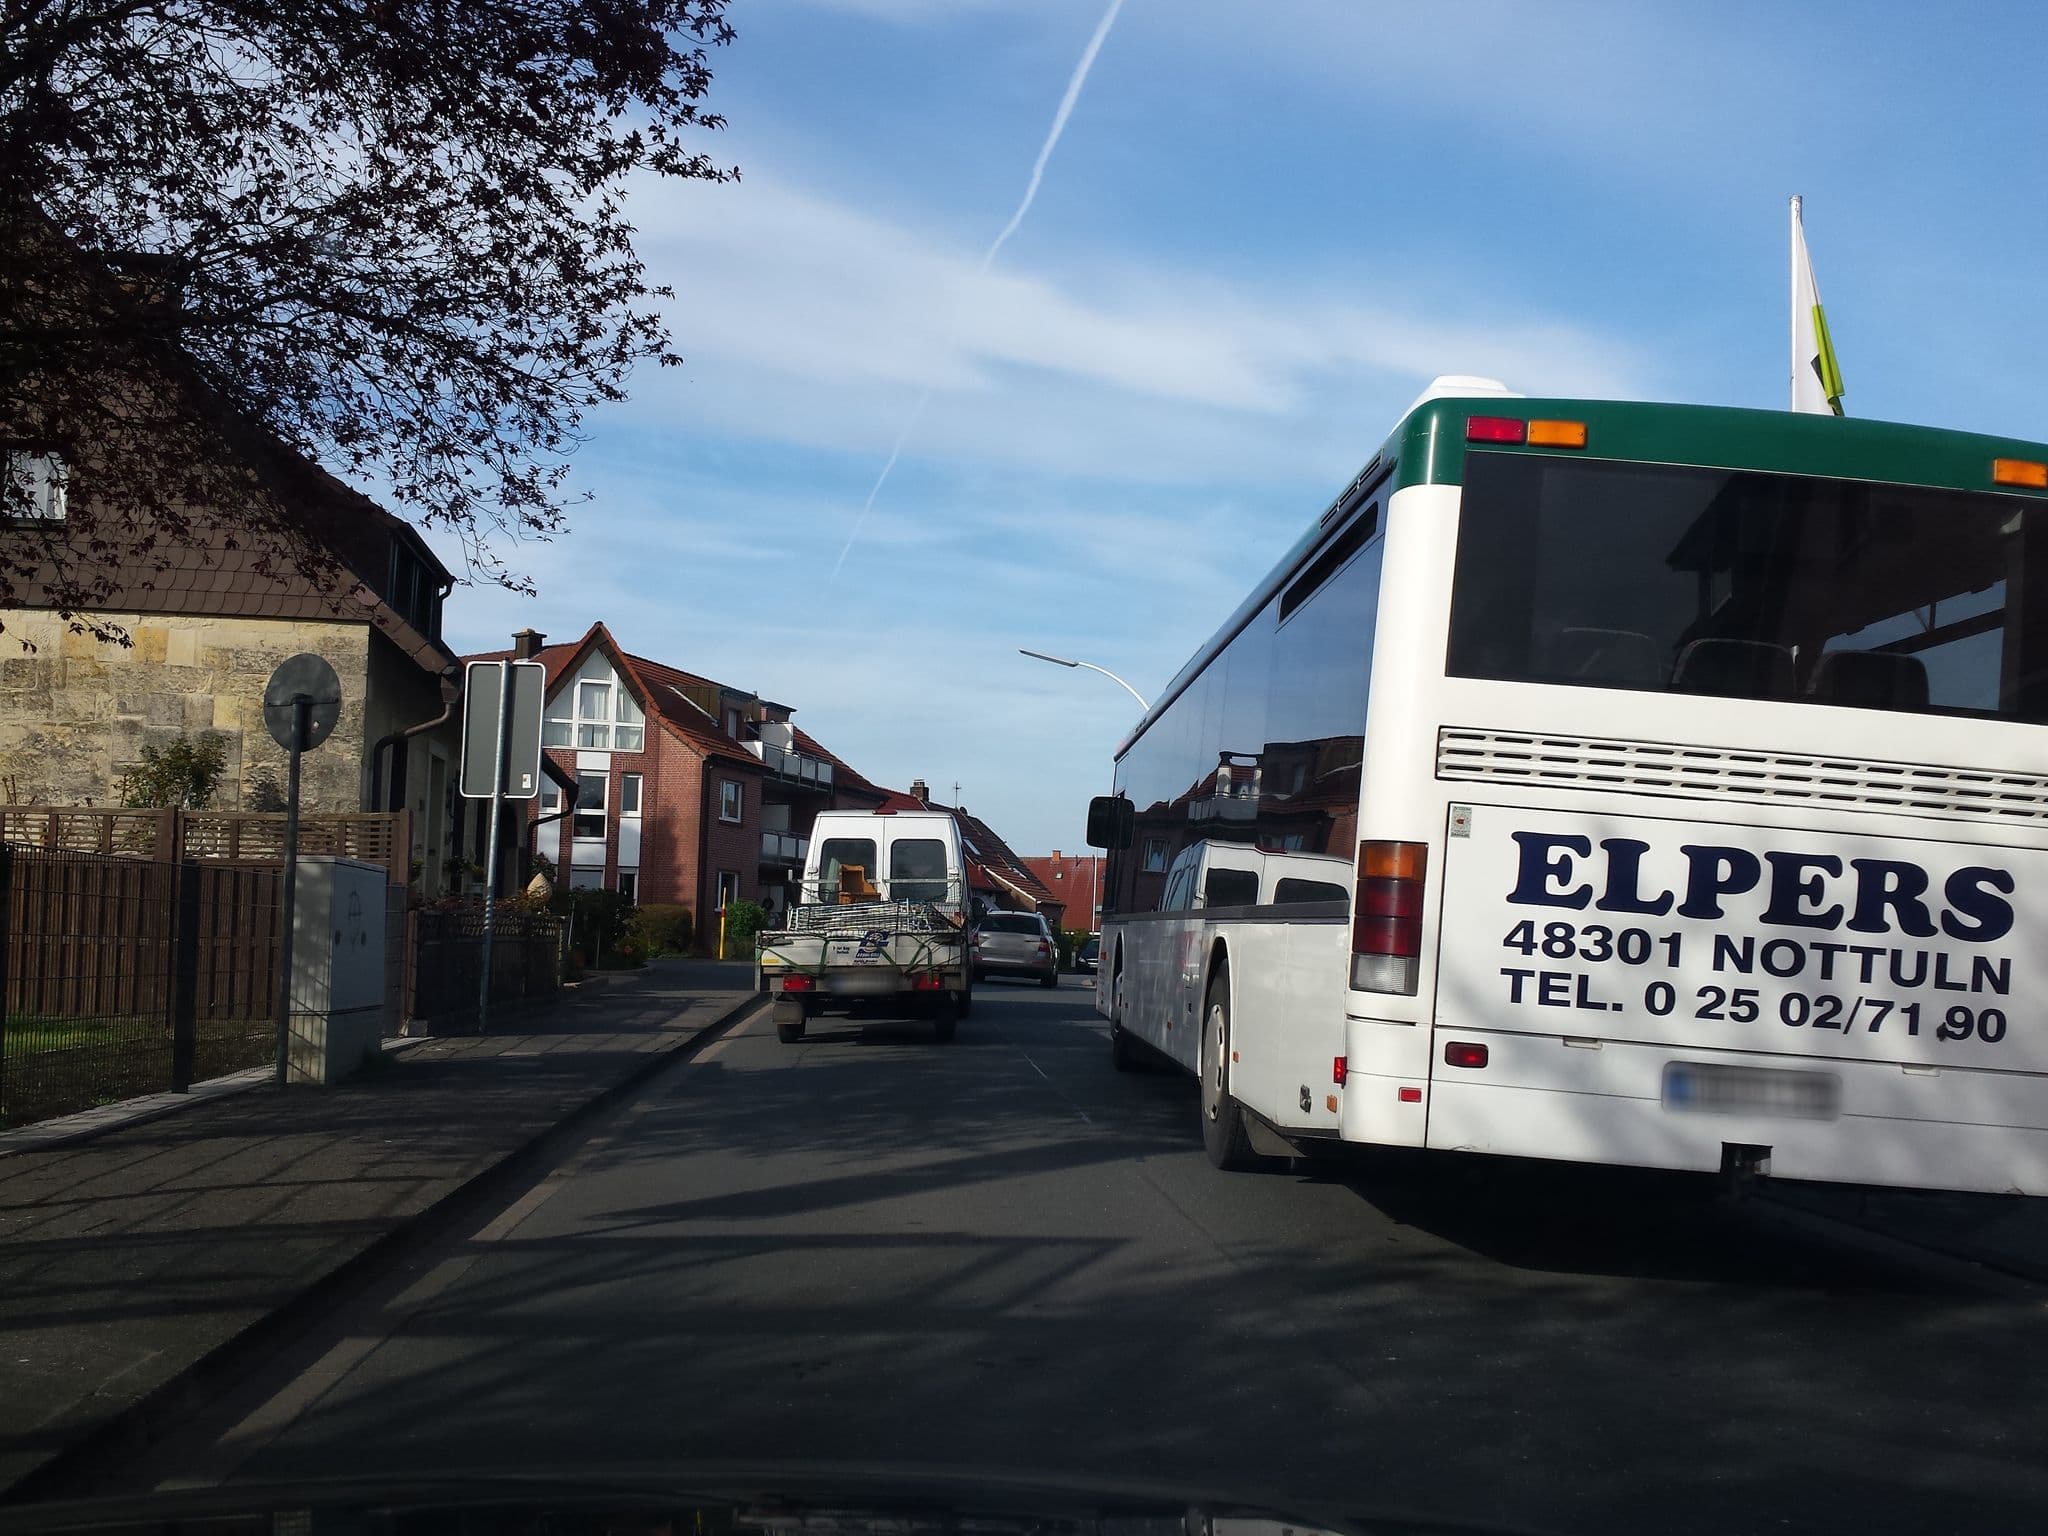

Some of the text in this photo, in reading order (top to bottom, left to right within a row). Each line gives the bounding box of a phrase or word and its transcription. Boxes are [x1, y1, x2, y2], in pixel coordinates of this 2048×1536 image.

[1506, 830, 2015, 943] ELPERS
[1502, 919, 2012, 996] 48301 NOTTULN
[1500, 967, 2008, 1044] TEL. 0 25 02/71 90
